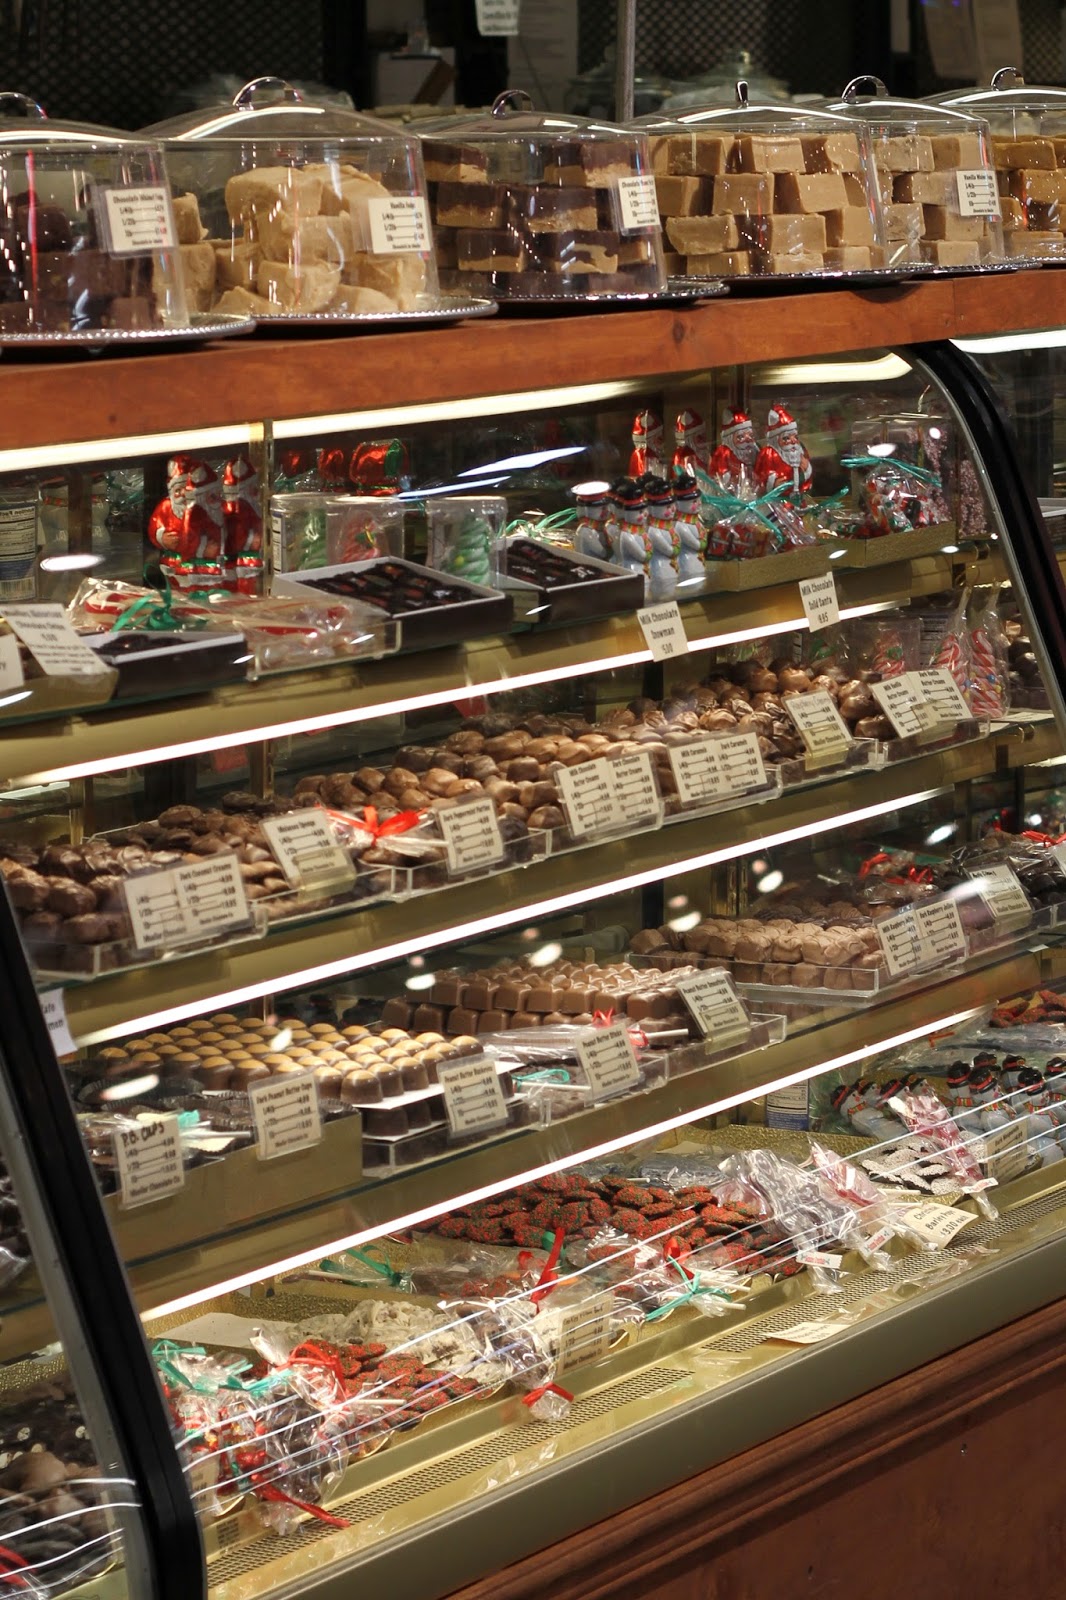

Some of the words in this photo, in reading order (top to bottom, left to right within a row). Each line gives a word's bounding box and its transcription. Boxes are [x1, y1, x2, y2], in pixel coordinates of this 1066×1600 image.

[801, 585, 812, 596] Milk
[811, 580, 834, 592] Chocolate
[808, 599, 819, 610] Solid
[818, 596, 832, 607] Santa
[639, 614, 652, 624] Milk
[650, 609, 678, 622] Chocolate
[650, 627, 675, 639] Snowman
[622, 756, 640, 765] Chocolate
[578, 763, 596, 771] Chocolate
[453, 809, 476, 818] Peppermint
[180, 872, 191, 880] Dark
[927, 906, 943, 916] Raspberry
[582, 1039, 596, 1047] Peanut
[596, 1035, 609, 1043] Butter
[444, 1074, 459, 1083] Peanut
[460, 1071, 473, 1079] Butter
[256, 1096, 267, 1104] Dark
[268, 1090, 284, 1099] Peanut
[285, 1087, 300, 1095] Butter
[121, 1130, 139, 1148] P.B.
[141, 1121, 164, 1142] CUPS
[925, 1212, 947, 1230] Barley
